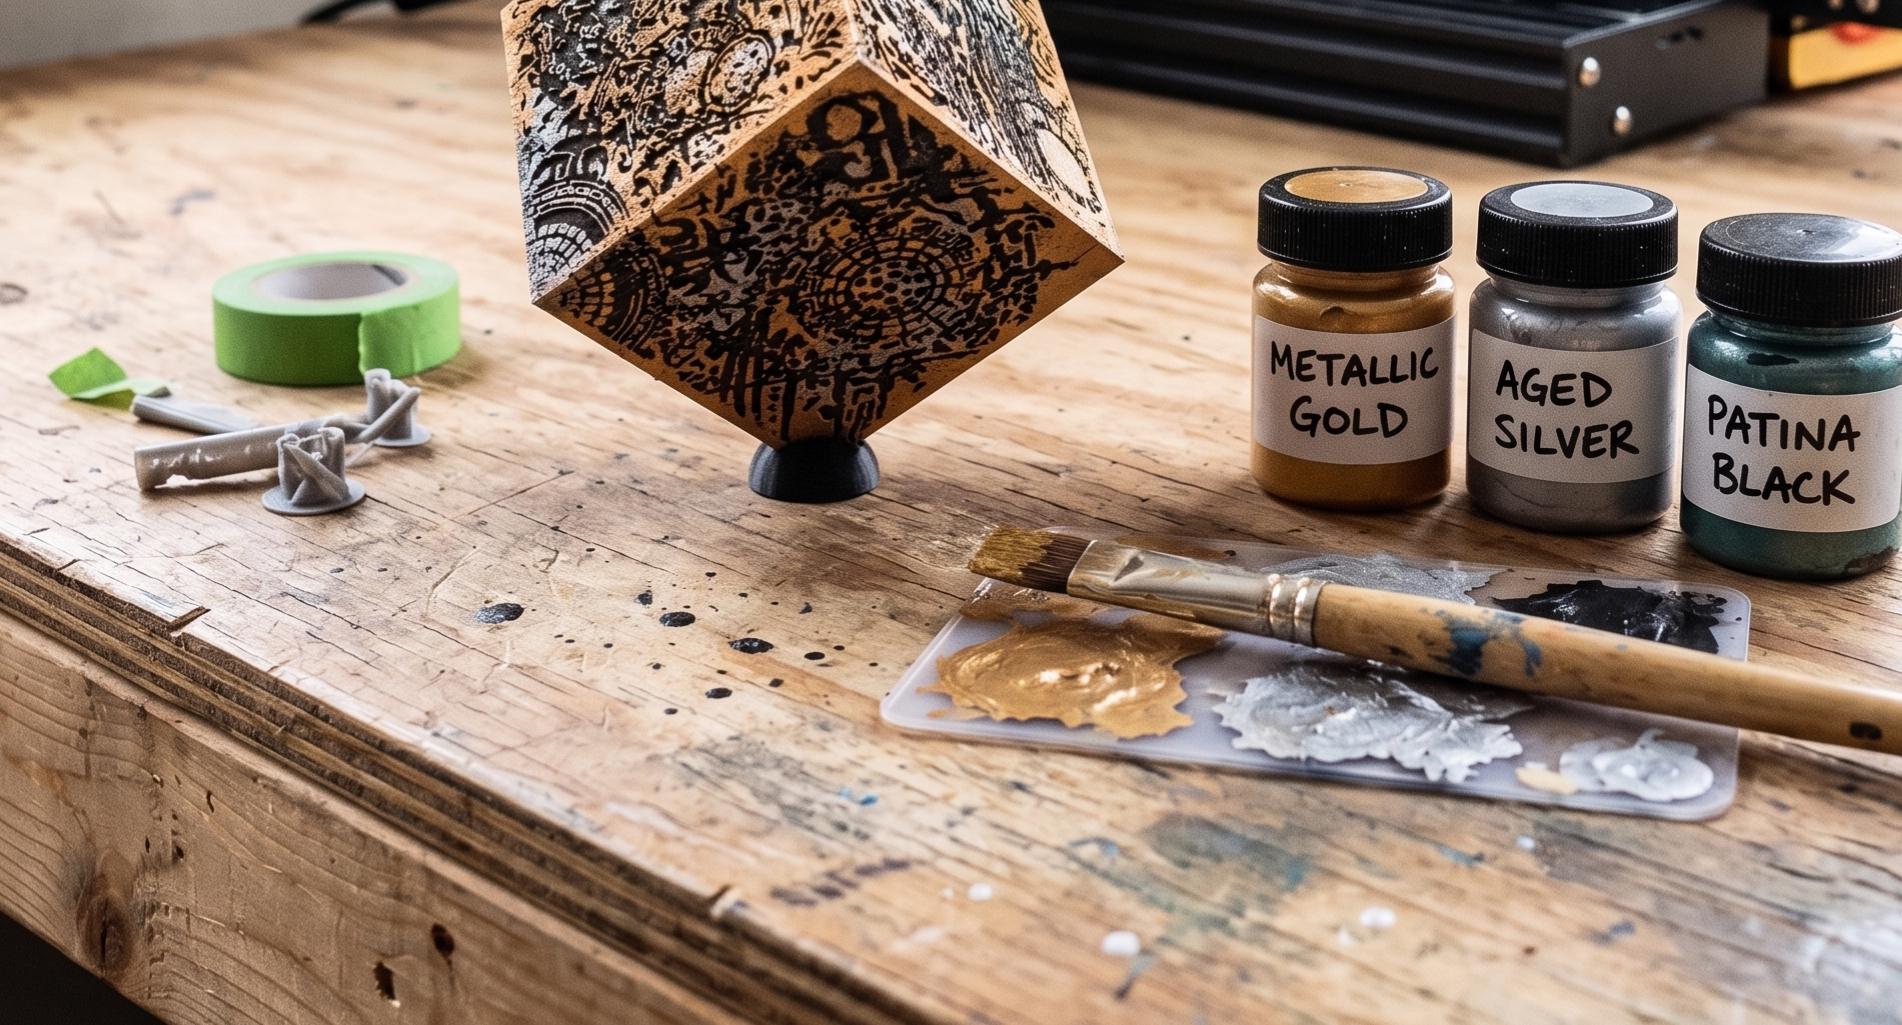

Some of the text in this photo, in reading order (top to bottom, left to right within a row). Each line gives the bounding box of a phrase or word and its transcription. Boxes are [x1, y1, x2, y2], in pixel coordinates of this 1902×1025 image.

[1271, 340, 1439, 387] METALLIC
[1495, 359, 1613, 408] AGED
[1289, 395, 1409, 438] GOLD
[1494, 413, 1641, 459] SILVER
[1707, 394, 1861, 452] PATINA
[1711, 451, 1856, 506] BLACK
